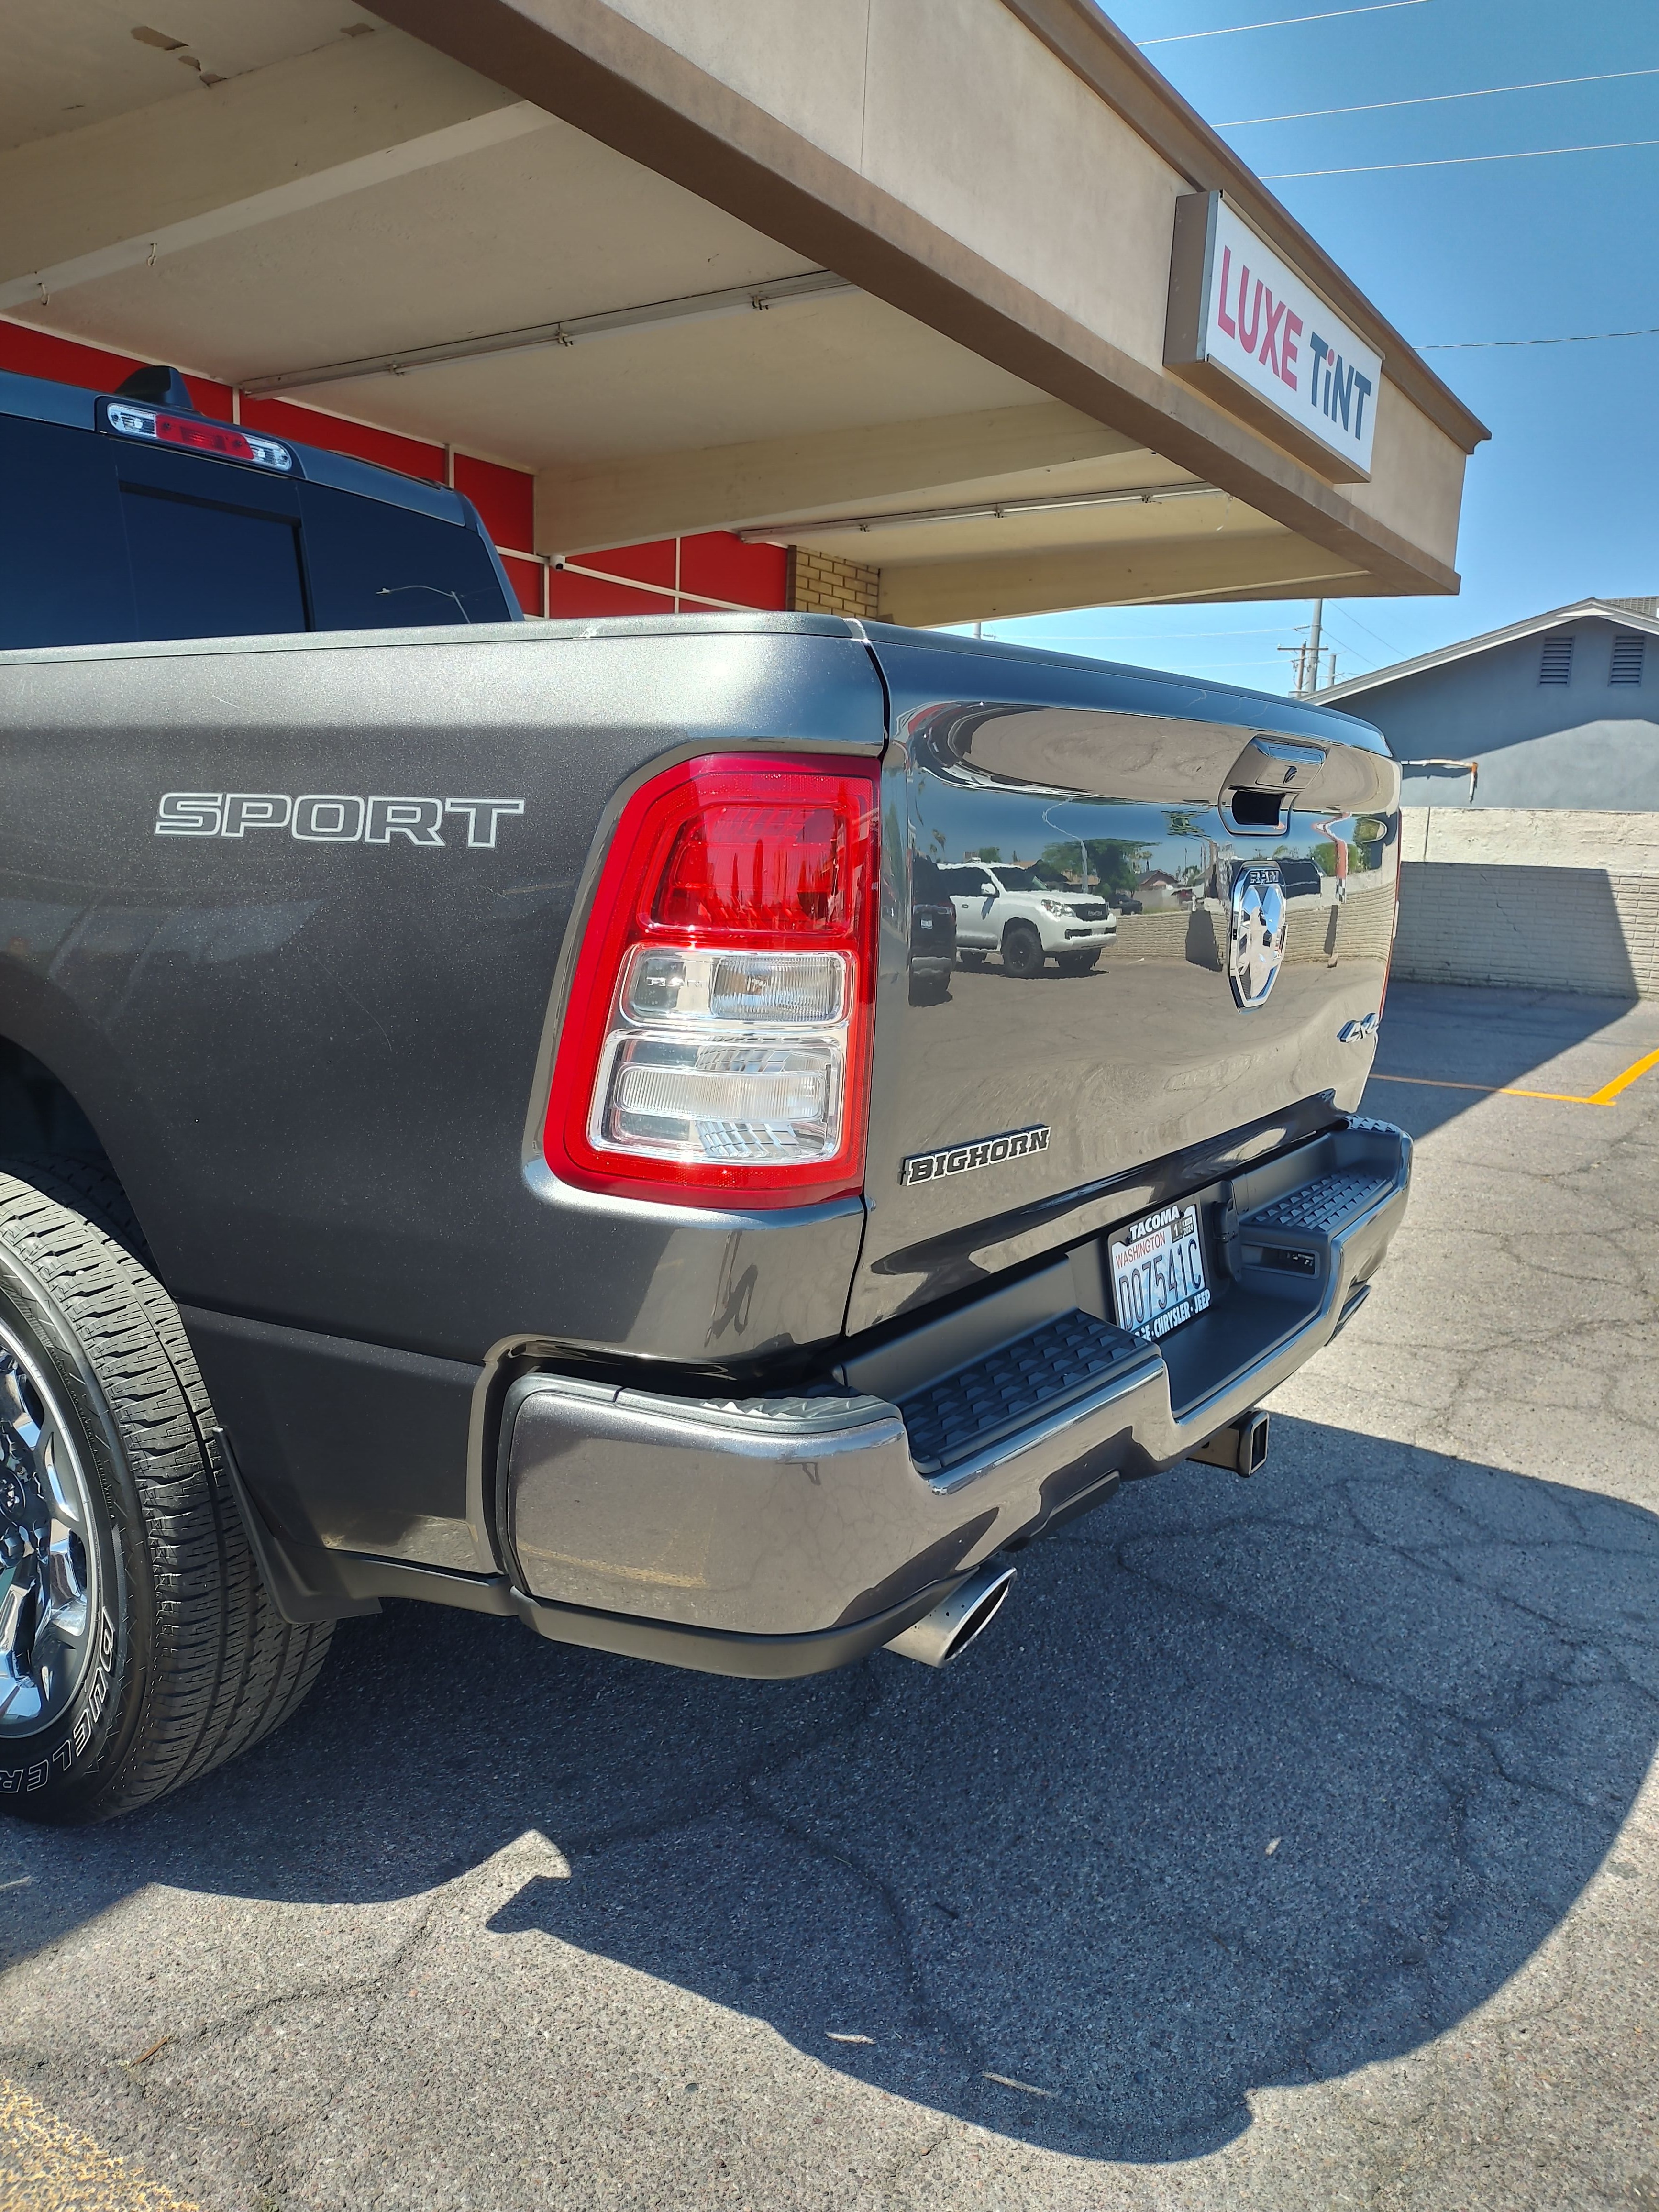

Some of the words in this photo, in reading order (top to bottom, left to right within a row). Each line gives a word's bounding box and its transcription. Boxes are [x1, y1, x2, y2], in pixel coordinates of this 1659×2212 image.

[1217, 244, 1304, 392] LUXE
[154, 792, 526, 848] SPORT
[1249, 870, 1279, 884] RAM
[906, 1126, 1051, 1186] BIGHORN
[1129, 1205, 1180, 1241] TACOMA
[1116, 1231, 1166, 1269] WASHINGTON
[1153, 1300, 1191, 1338] CHRYSLER
[1194, 1289, 1211, 1314] JEEP
[0, 1606, 114, 1793] DUELER
